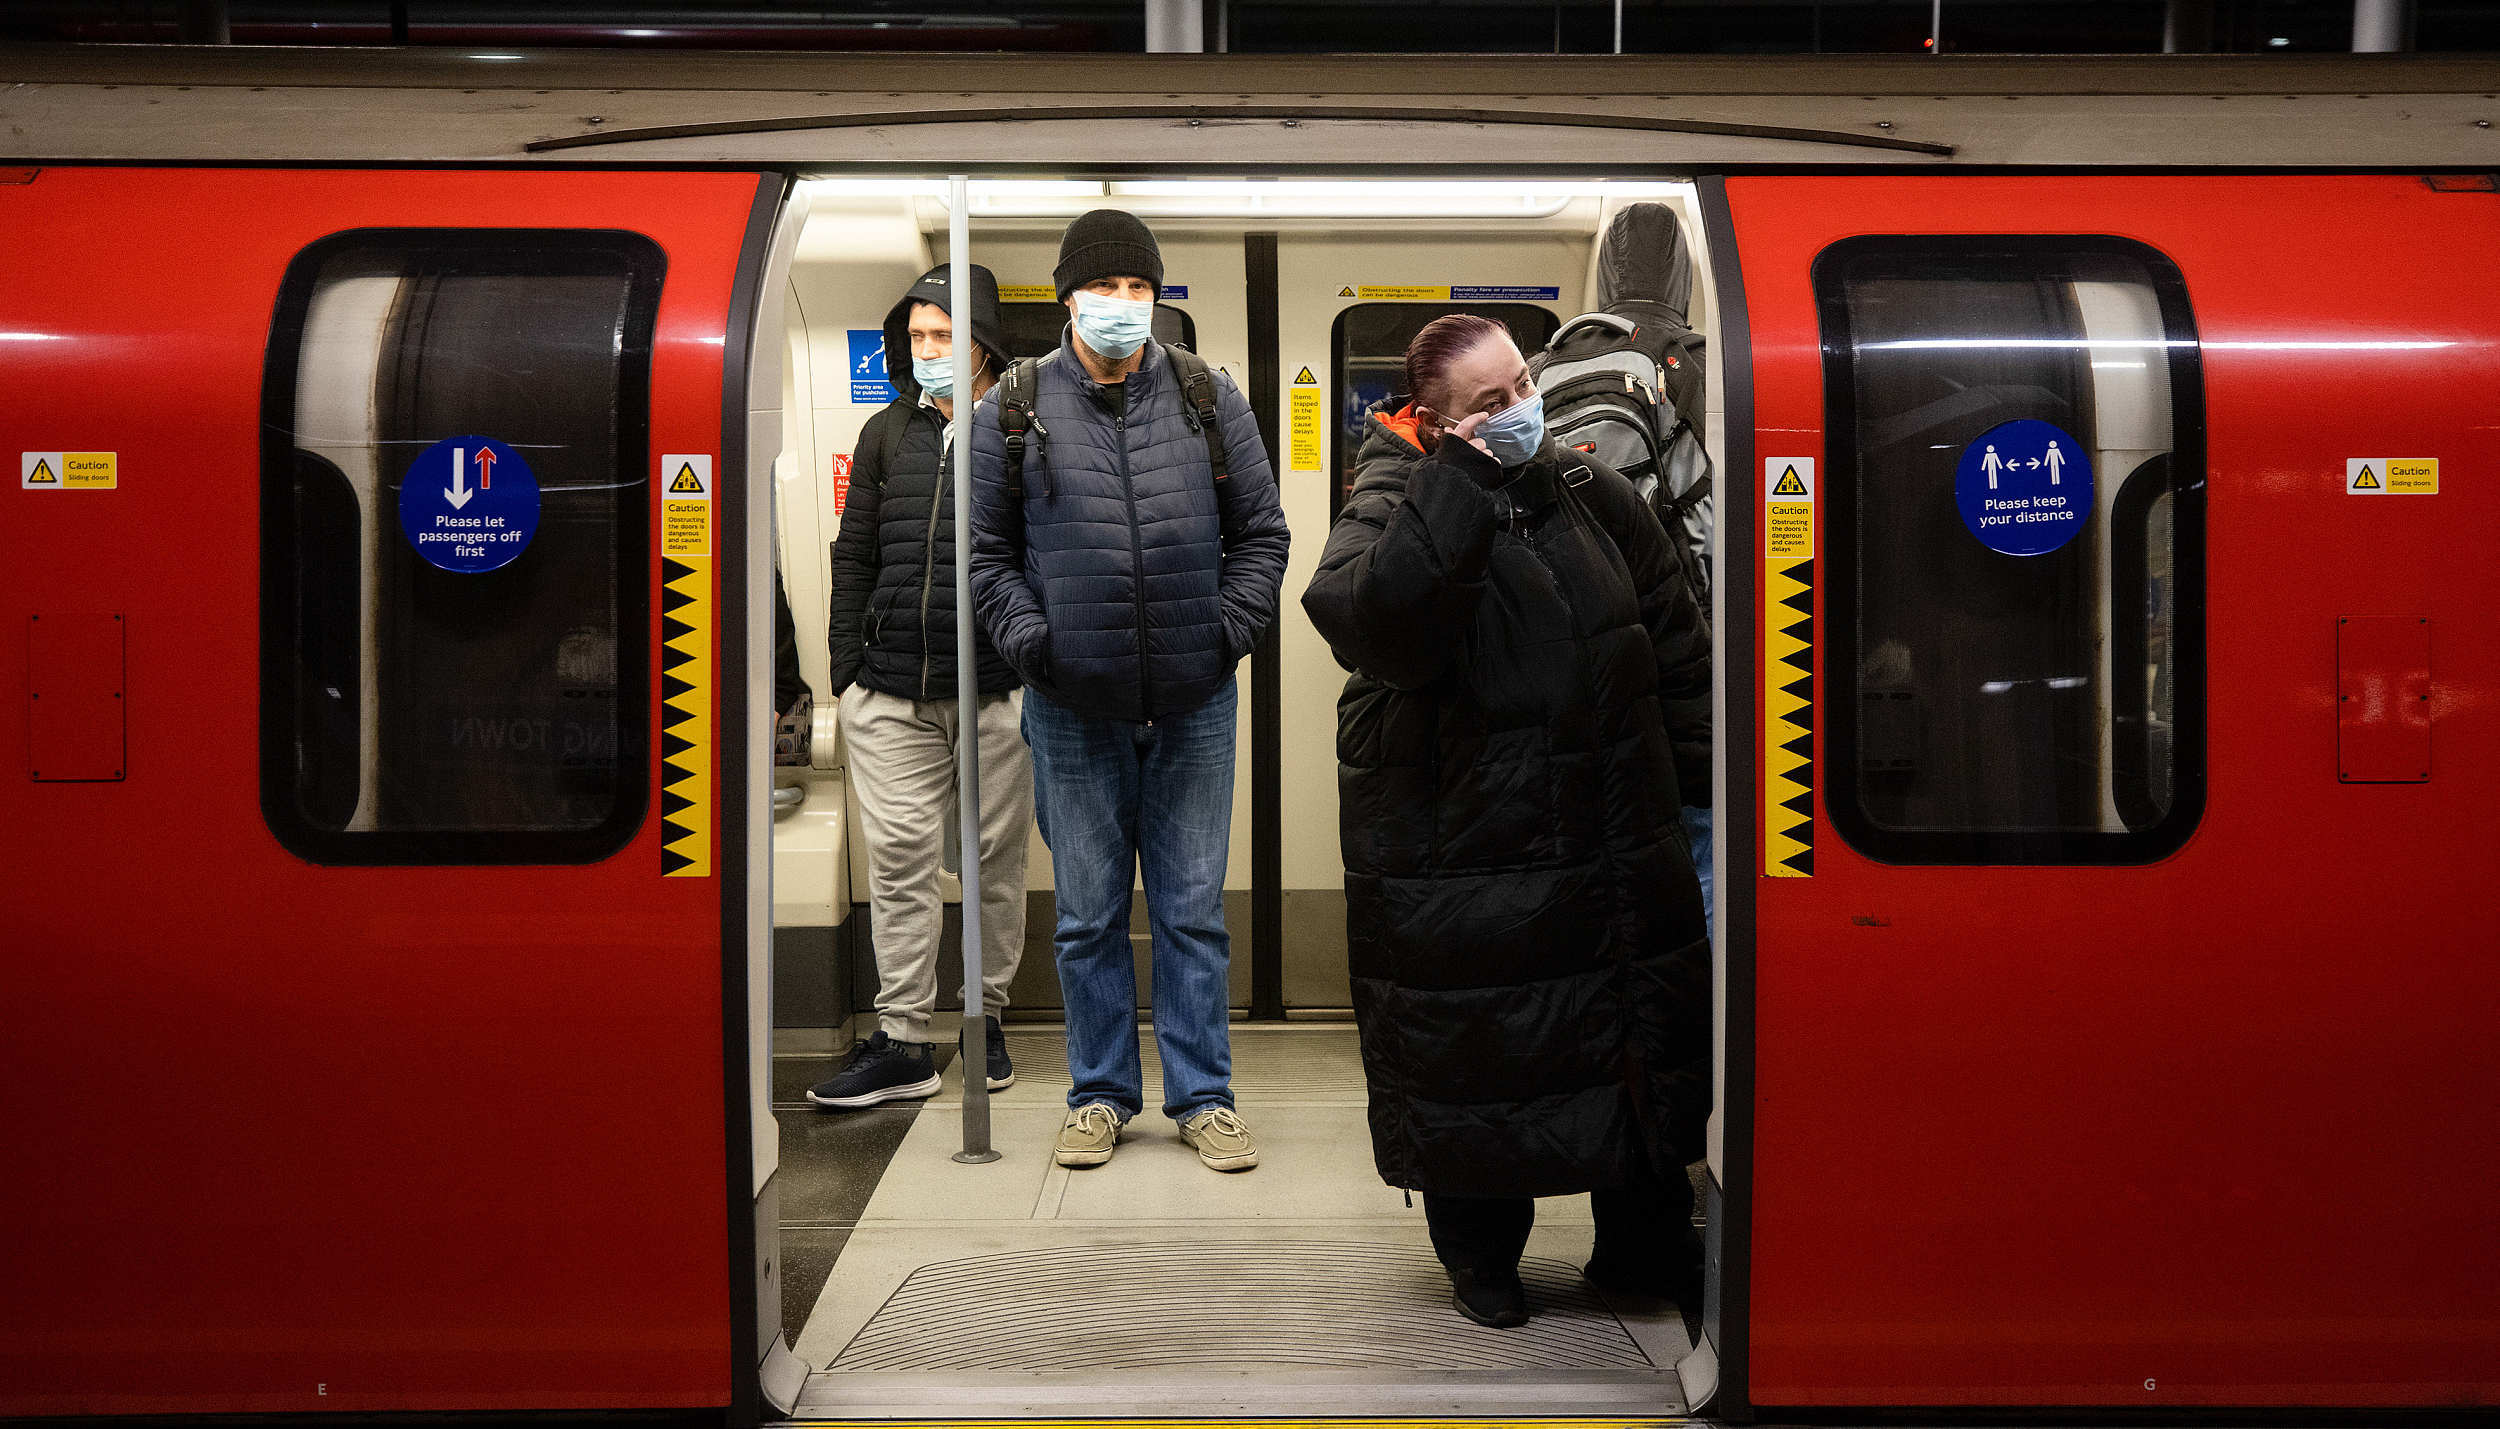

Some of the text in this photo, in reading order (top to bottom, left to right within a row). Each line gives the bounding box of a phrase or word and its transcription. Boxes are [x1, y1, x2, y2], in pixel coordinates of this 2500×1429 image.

[68, 461, 109, 470] Caution
[2391, 467, 2430, 476] Caution
[837, 478, 850, 486] Ala
[668, 504, 706, 512] Caution
[1985, 496, 2067, 511] Please keep
[1771, 506, 1809, 515] Caution
[436, 515, 505, 527] Please let
[1979, 511, 2074, 528] your distance
[419, 530, 522, 545] passengers off
[455, 545, 485, 557] first
[318, 1383, 328, 1396] E
[2144, 1378, 2156, 1391] G
